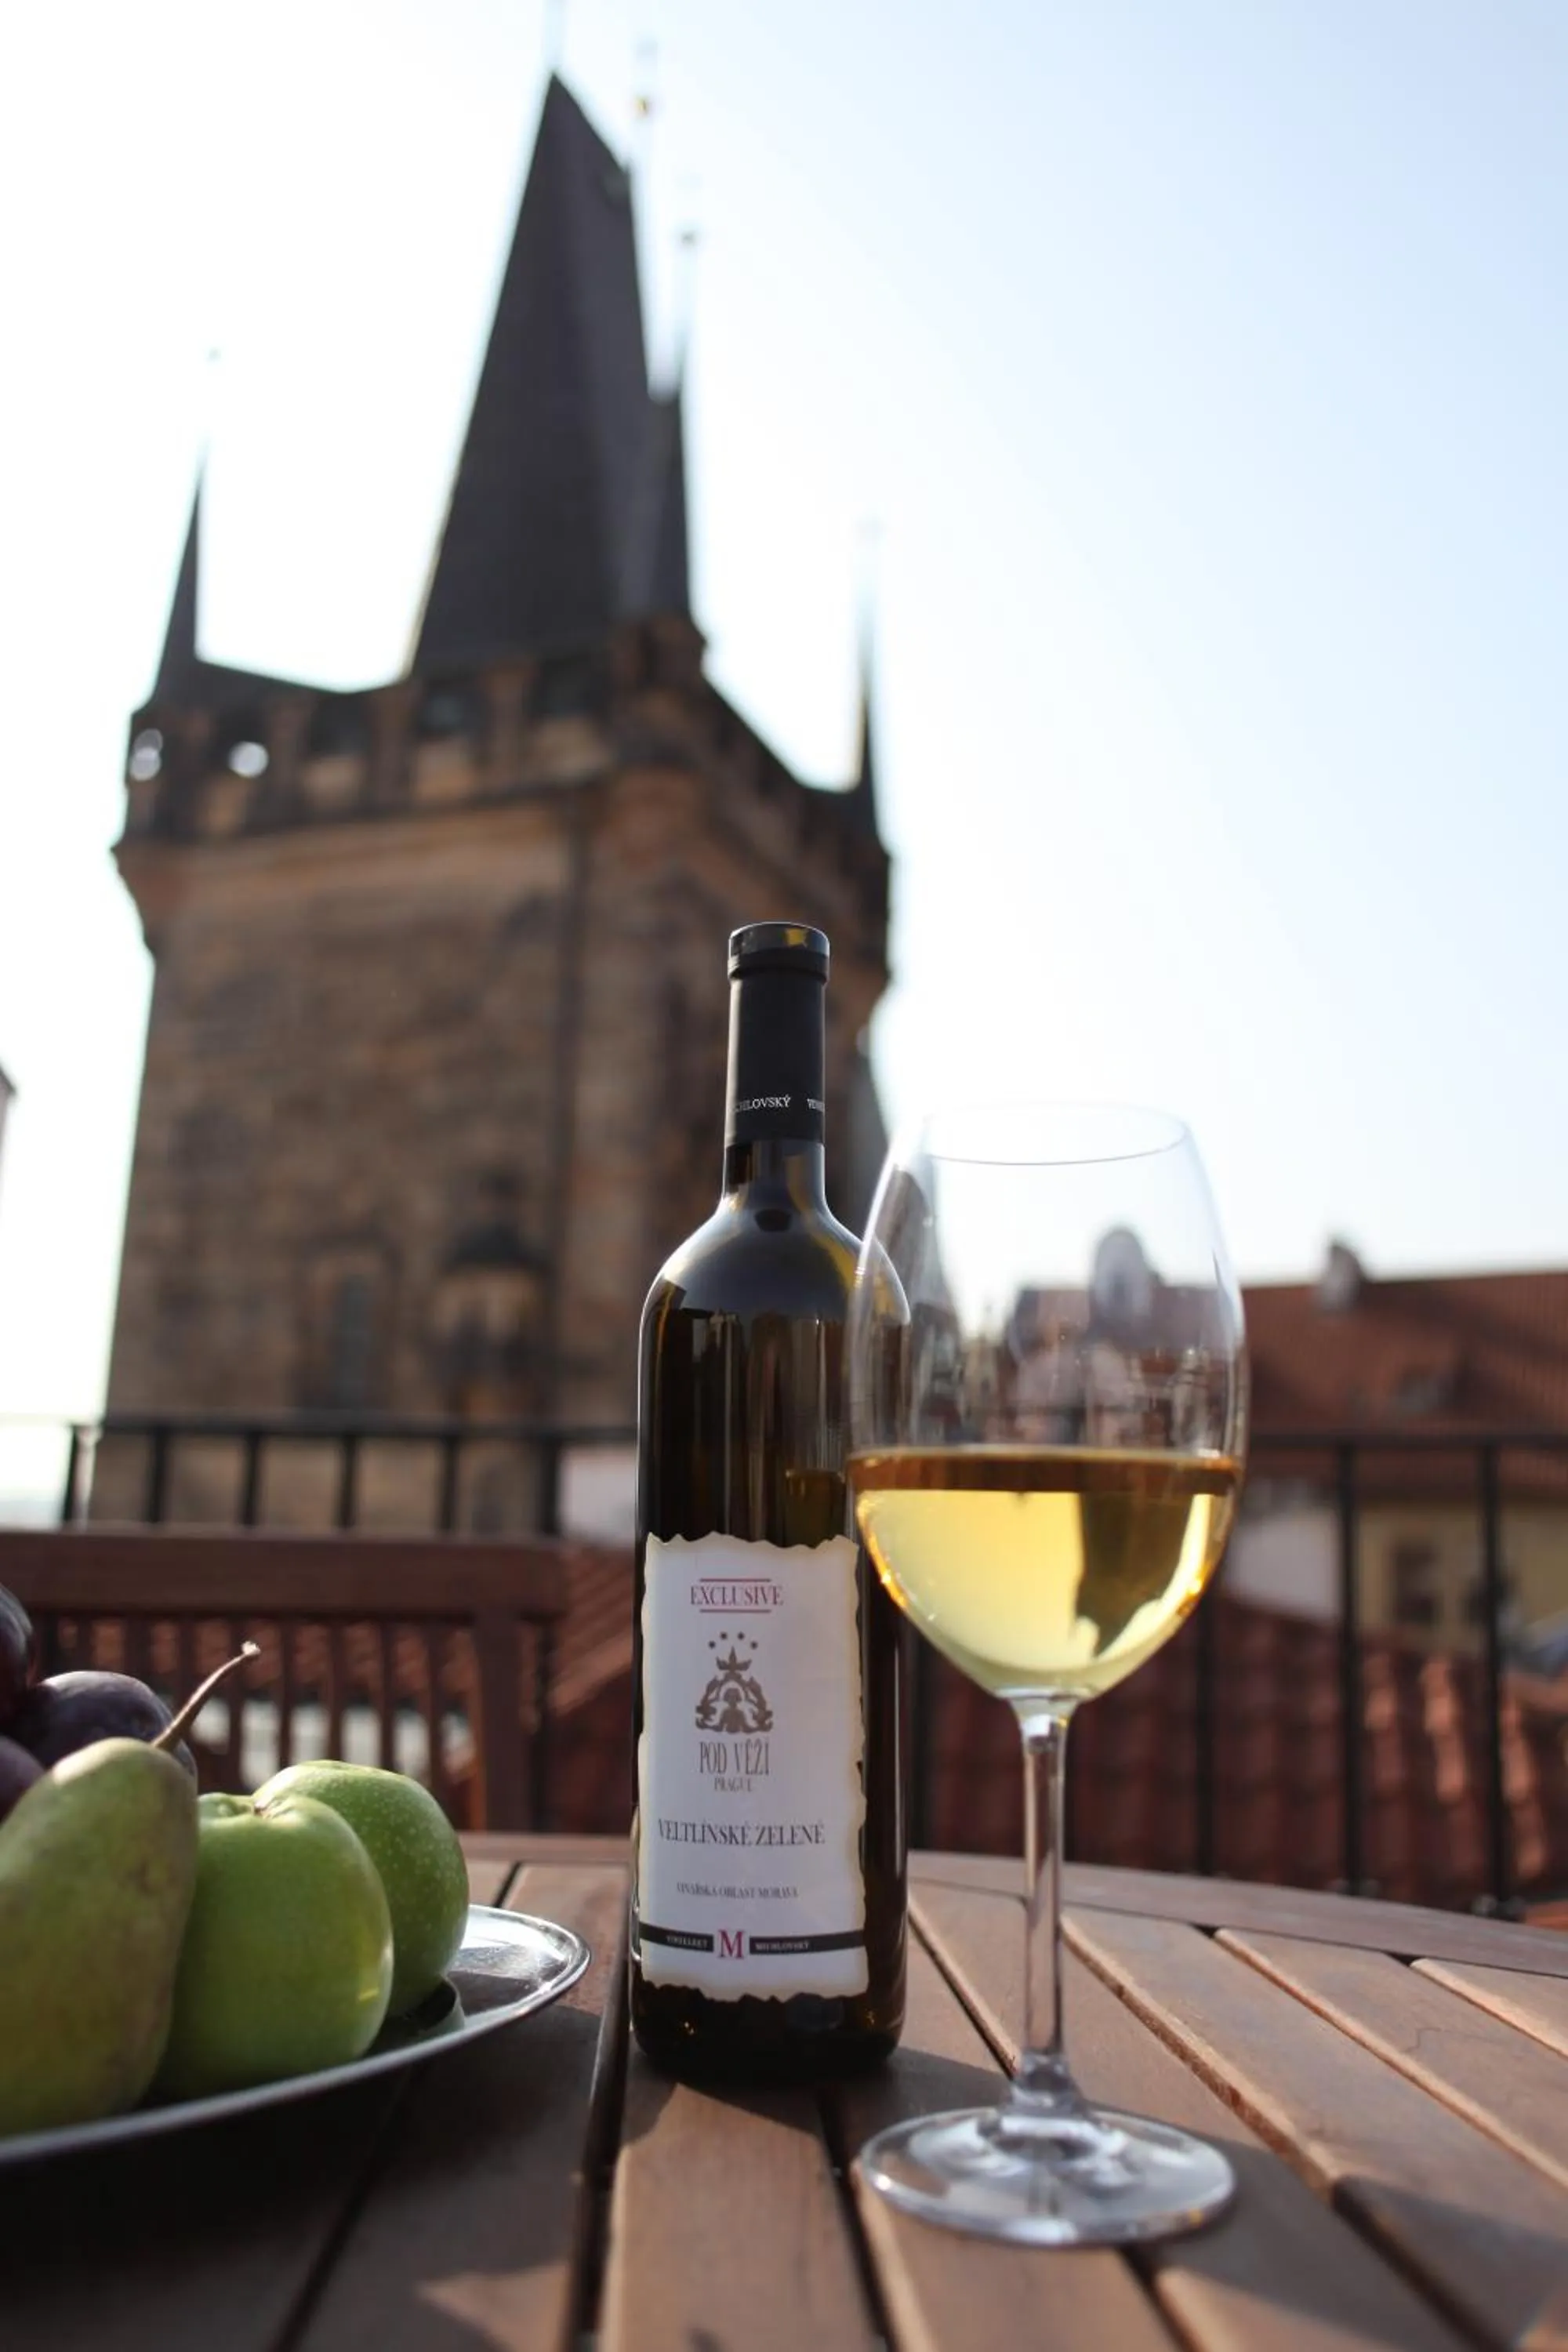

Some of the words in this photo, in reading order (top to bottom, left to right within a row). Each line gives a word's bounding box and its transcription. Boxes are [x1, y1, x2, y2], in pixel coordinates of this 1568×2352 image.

[691, 1585, 784, 1606] EXCLUSIVE
[699, 1740, 728, 1774] POD
[658, 1817, 753, 1846] VELTLÍNSKÉ
[755, 1819, 826, 1847] ZELENÉ
[718, 1929, 745, 1959] M
